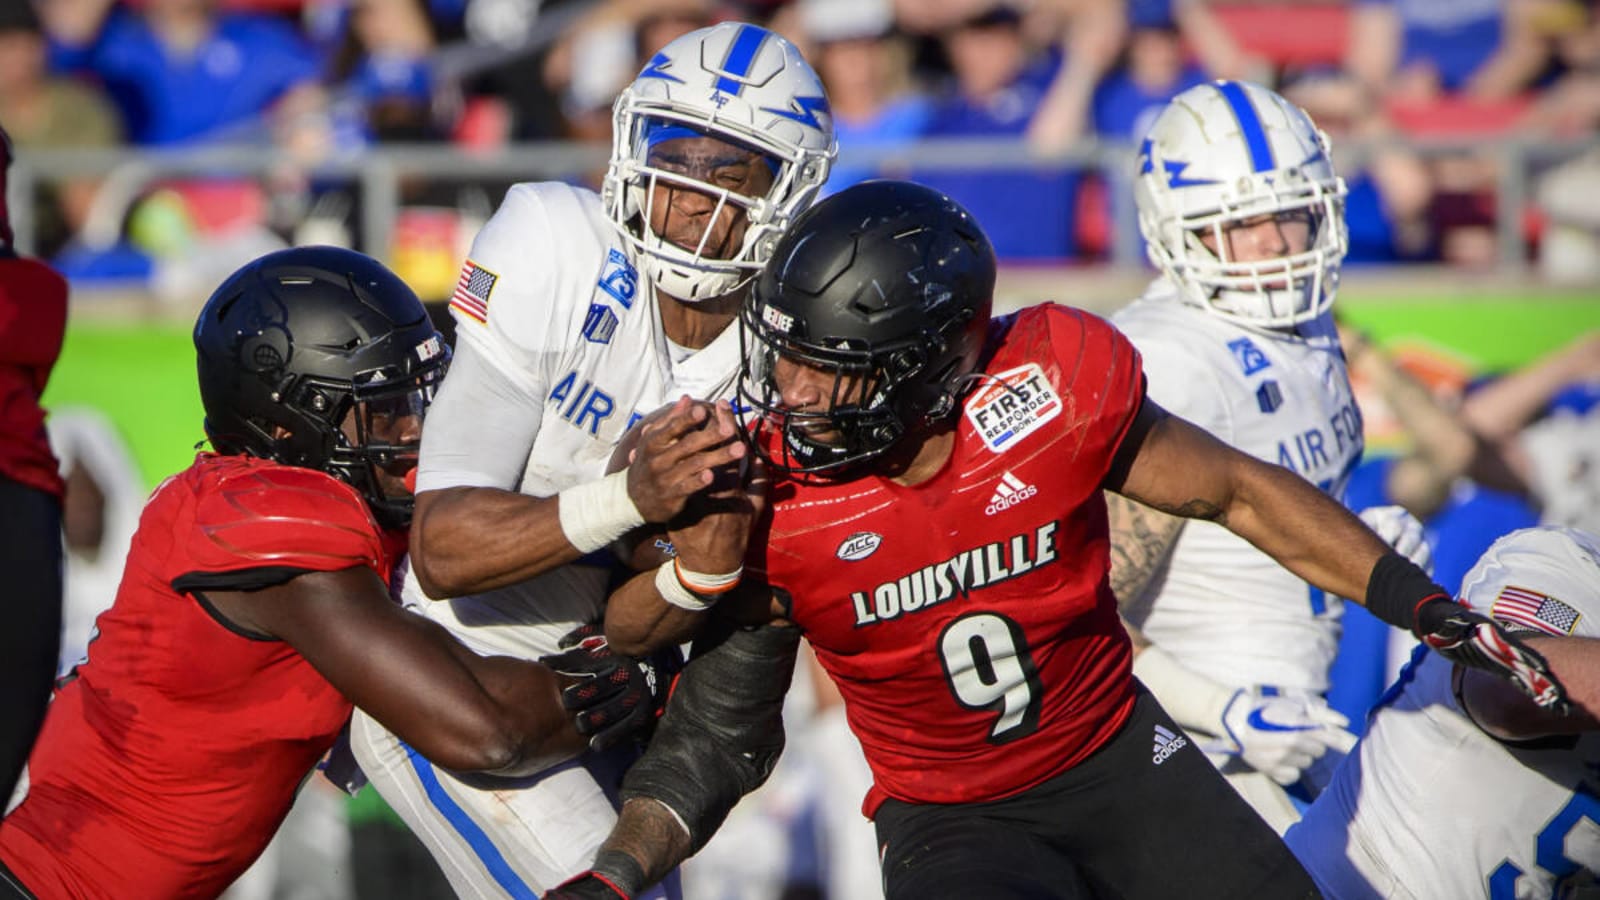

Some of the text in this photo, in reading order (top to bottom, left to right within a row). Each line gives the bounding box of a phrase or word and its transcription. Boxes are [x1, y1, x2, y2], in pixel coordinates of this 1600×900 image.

[548, 371, 616, 438] AIR
[986, 391, 1052, 439] RESPONDER
[1012, 415, 1038, 434] BOWL
[1277, 428, 1330, 472] AIR
[984, 483, 1037, 516] adidas
[843, 535, 877, 557] ACC
[851, 520, 1059, 627] LOUISVILLE
[938, 611, 1043, 745] 9
[1153, 736, 1187, 765] adidas
